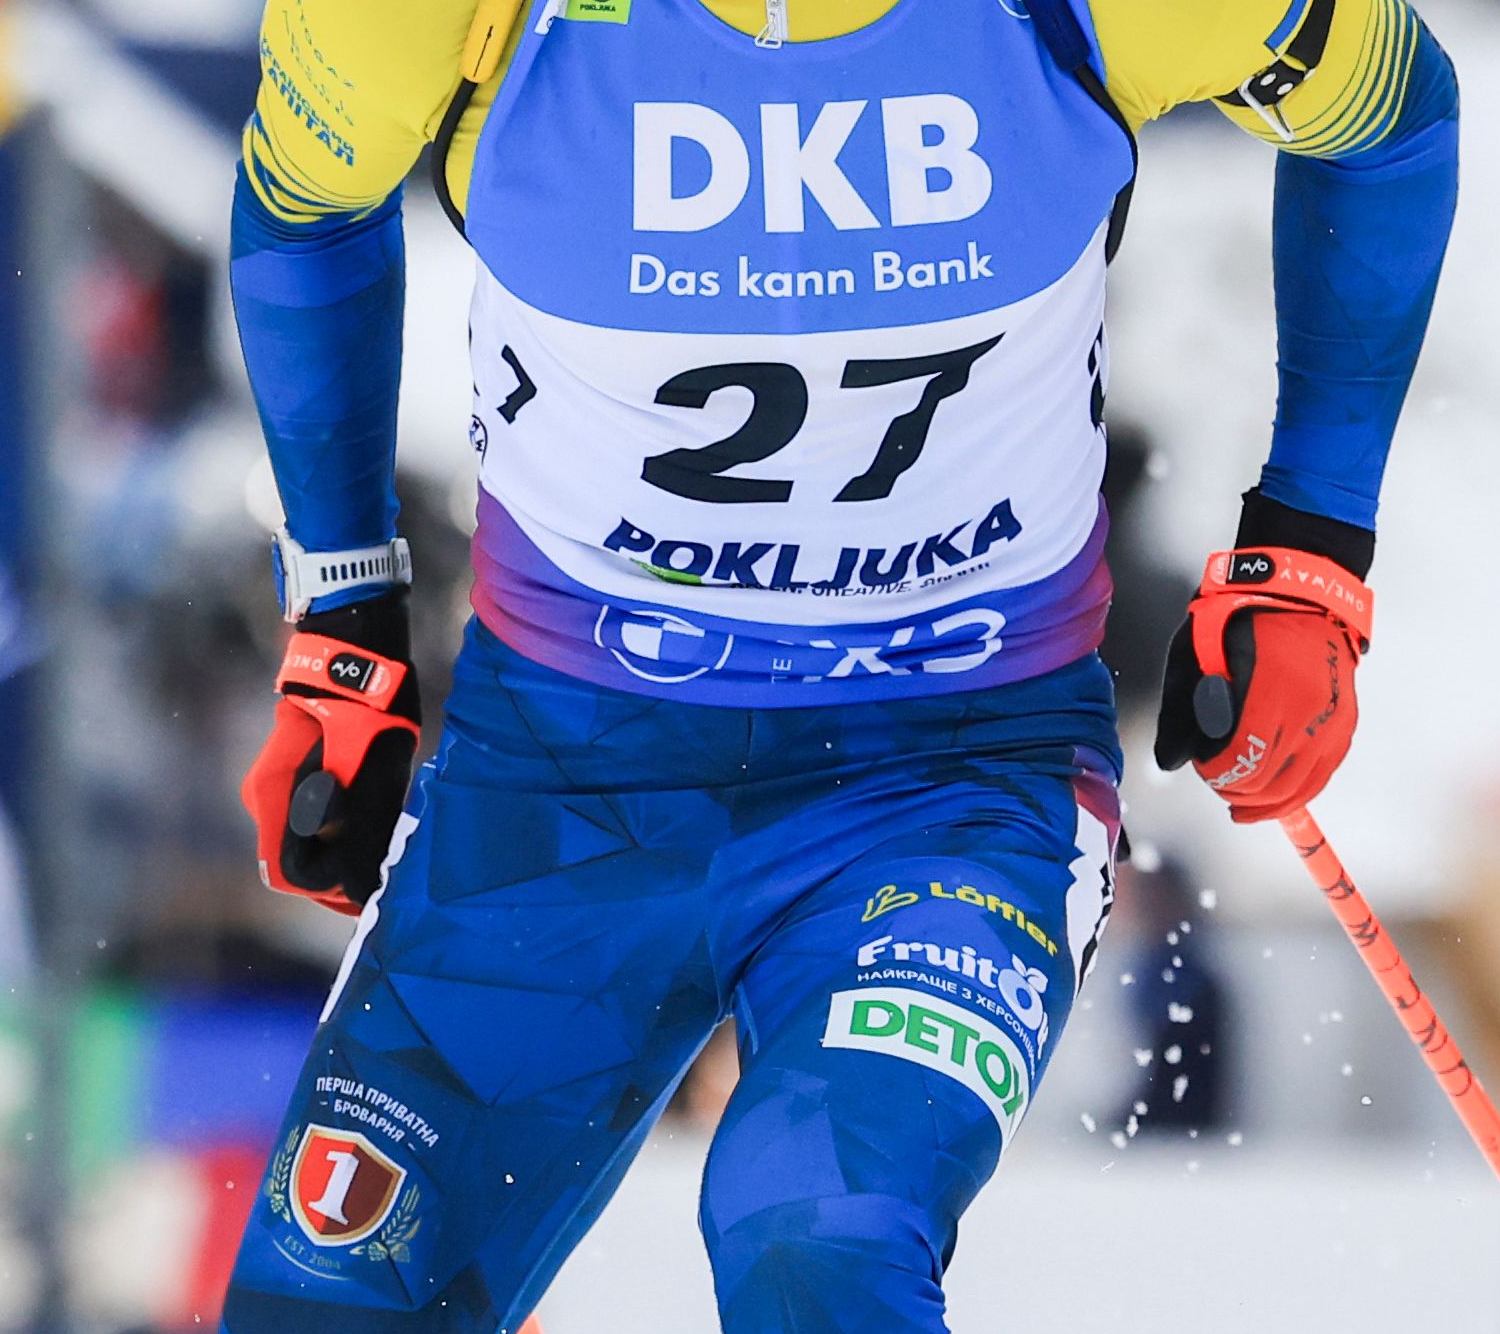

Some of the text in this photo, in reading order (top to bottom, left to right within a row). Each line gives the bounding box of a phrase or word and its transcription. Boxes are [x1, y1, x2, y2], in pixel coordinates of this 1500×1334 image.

[267, 66, 356, 169] АПІТАЛ
[632, 92, 993, 234] DKB
[630, 242, 993, 299] Das kann Bank
[640, 333, 1005, 504] 27
[603, 497, 1023, 590] POKLJUKA
[857, 970, 958, 995] НАЙКРАЩЕ
[316, 1076, 440, 1148] ПЕРША ПРИВАТНА
[333, 1098, 406, 1144] БРОВАРНЯ
[307, 1150, 360, 1227] 1
